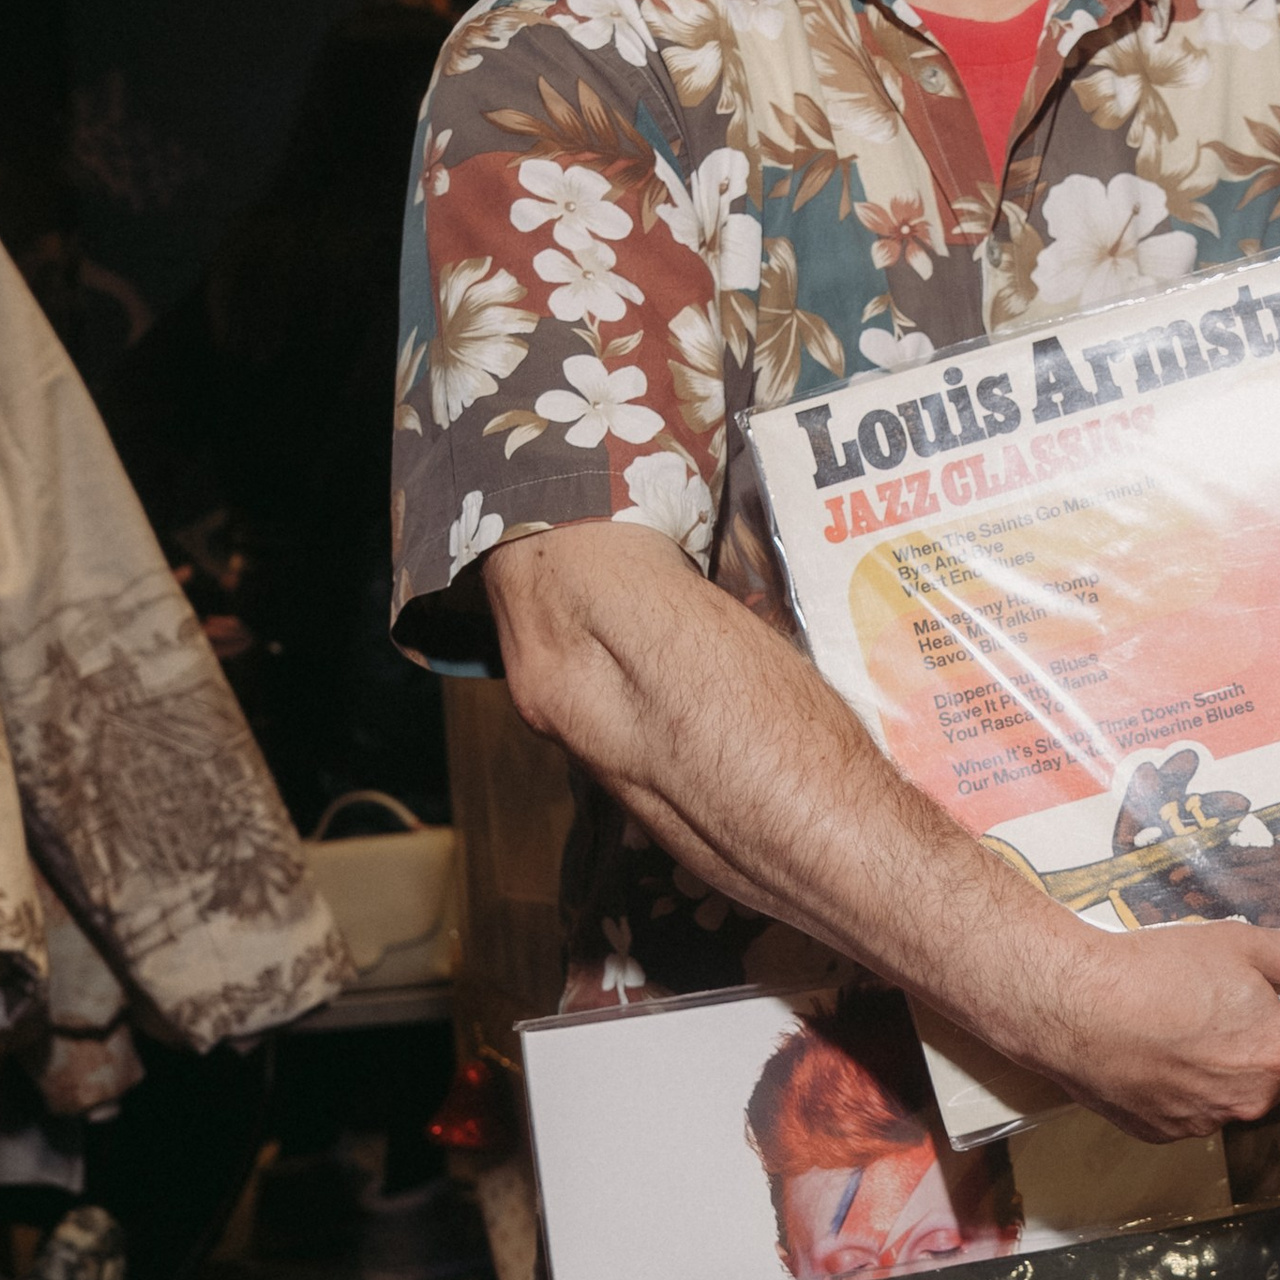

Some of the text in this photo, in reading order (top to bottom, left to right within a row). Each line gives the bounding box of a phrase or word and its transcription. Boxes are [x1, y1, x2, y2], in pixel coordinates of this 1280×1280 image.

[795, 367, 1021, 489] Louis
[824, 469, 941, 543] JAZZ
[892, 506, 1060, 563] When Saints Go
[1075, 592, 1099, 605] Ya
[938, 700, 997, 727] Save It
[943, 726, 978, 744] You
[952, 751, 1004, 777] When
[1141, 700, 1191, 723] Down
[1193, 682, 1245, 707] South
[958, 700, 1255, 795] Our Monday Wolverine Blues
